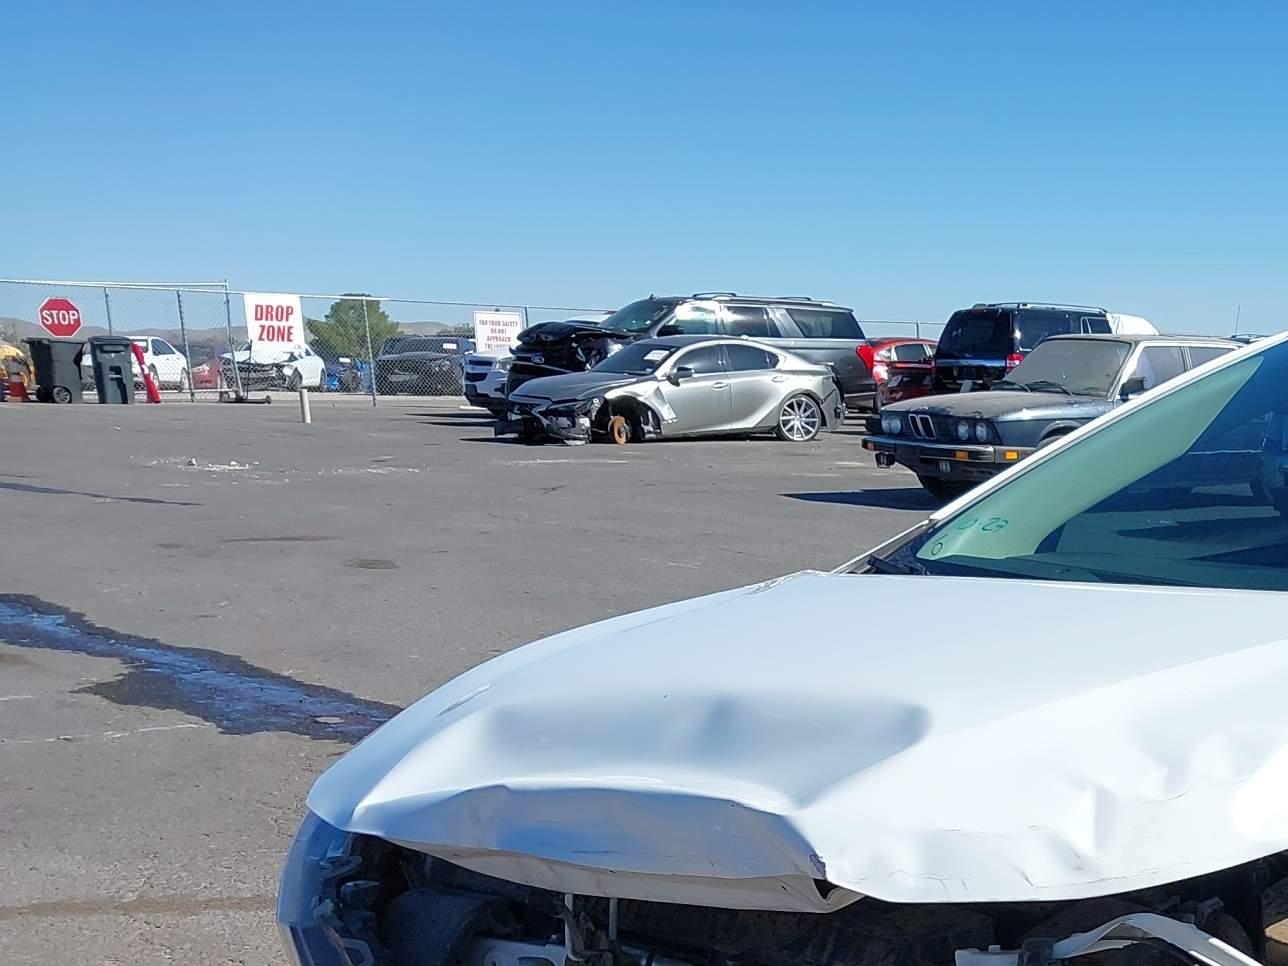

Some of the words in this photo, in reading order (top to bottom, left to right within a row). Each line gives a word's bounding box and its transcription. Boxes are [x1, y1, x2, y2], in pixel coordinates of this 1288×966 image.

[42, 310, 78, 325] STOP
[255, 304, 294, 322] DROP
[258, 325, 294, 342] ZONE
